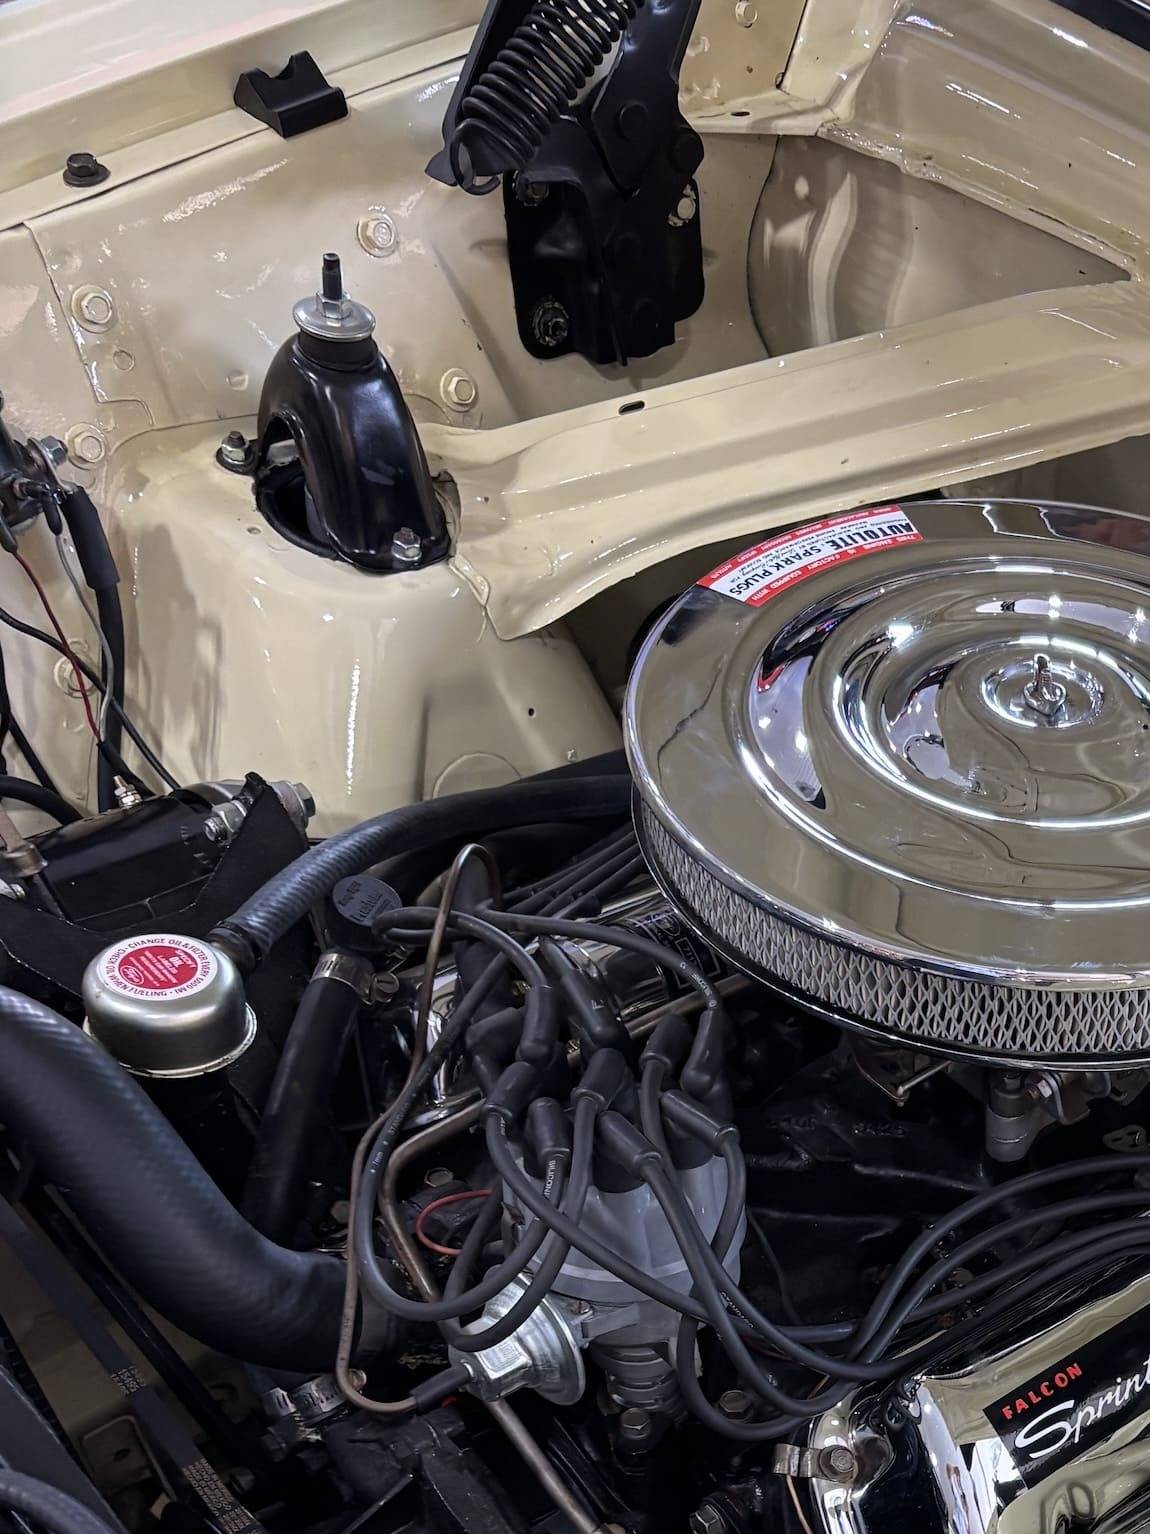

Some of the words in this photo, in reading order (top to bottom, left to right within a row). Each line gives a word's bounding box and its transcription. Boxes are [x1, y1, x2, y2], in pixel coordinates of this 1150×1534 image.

[826, 522, 914, 550] AUTOLITE
[769, 545, 821, 571] SPARK
[808, 555, 840, 570] FACTORY
[730, 569, 773, 595] PLUGS
[752, 589, 770, 600] WITH
[108, 948, 126, 964] CHECK
[128, 938, 165, 948] CHANGE
[188, 945, 208, 961] FILTER
[105, 965, 115, 975] OIL
[108, 973, 130, 990] WHEN
[128, 987, 167, 997] FUELING
[1001, 1362, 1083, 1421] FALCON
